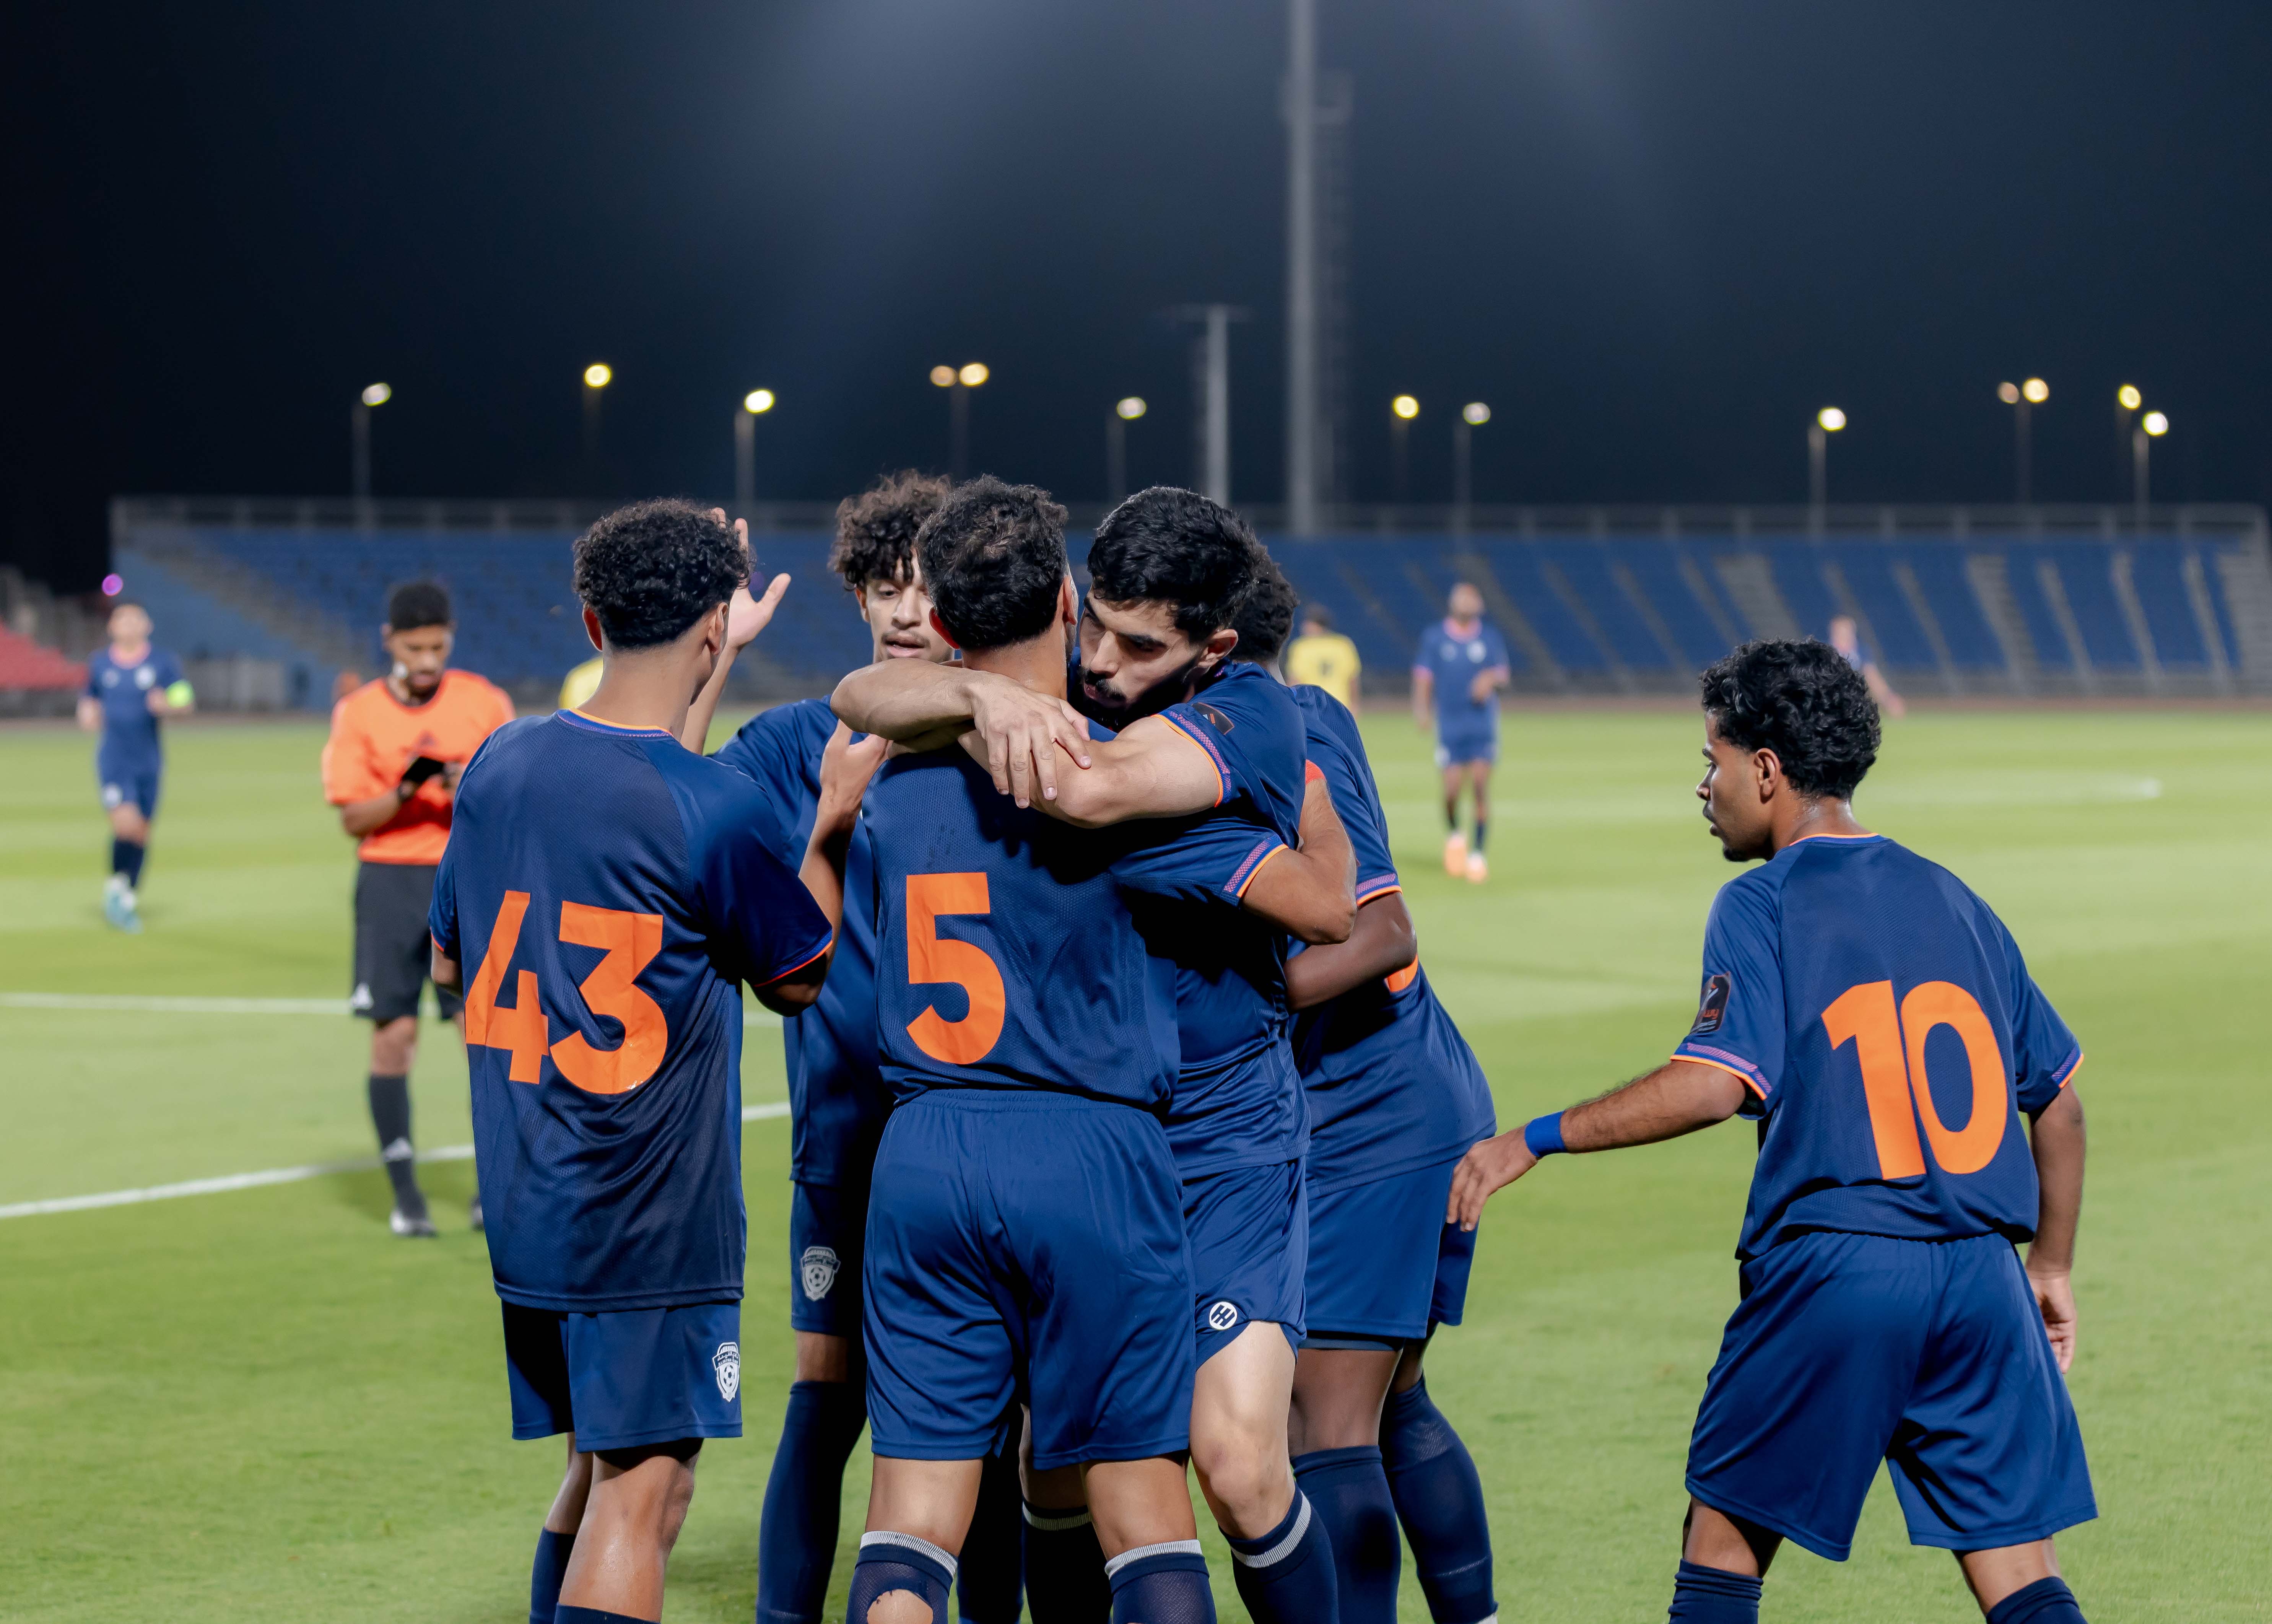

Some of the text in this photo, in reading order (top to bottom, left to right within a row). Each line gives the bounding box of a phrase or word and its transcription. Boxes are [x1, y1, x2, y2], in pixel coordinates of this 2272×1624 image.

[465, 890, 668, 1094] 43
[906, 872, 1005, 1064] 5
[1821, 980, 2008, 1180] 10
